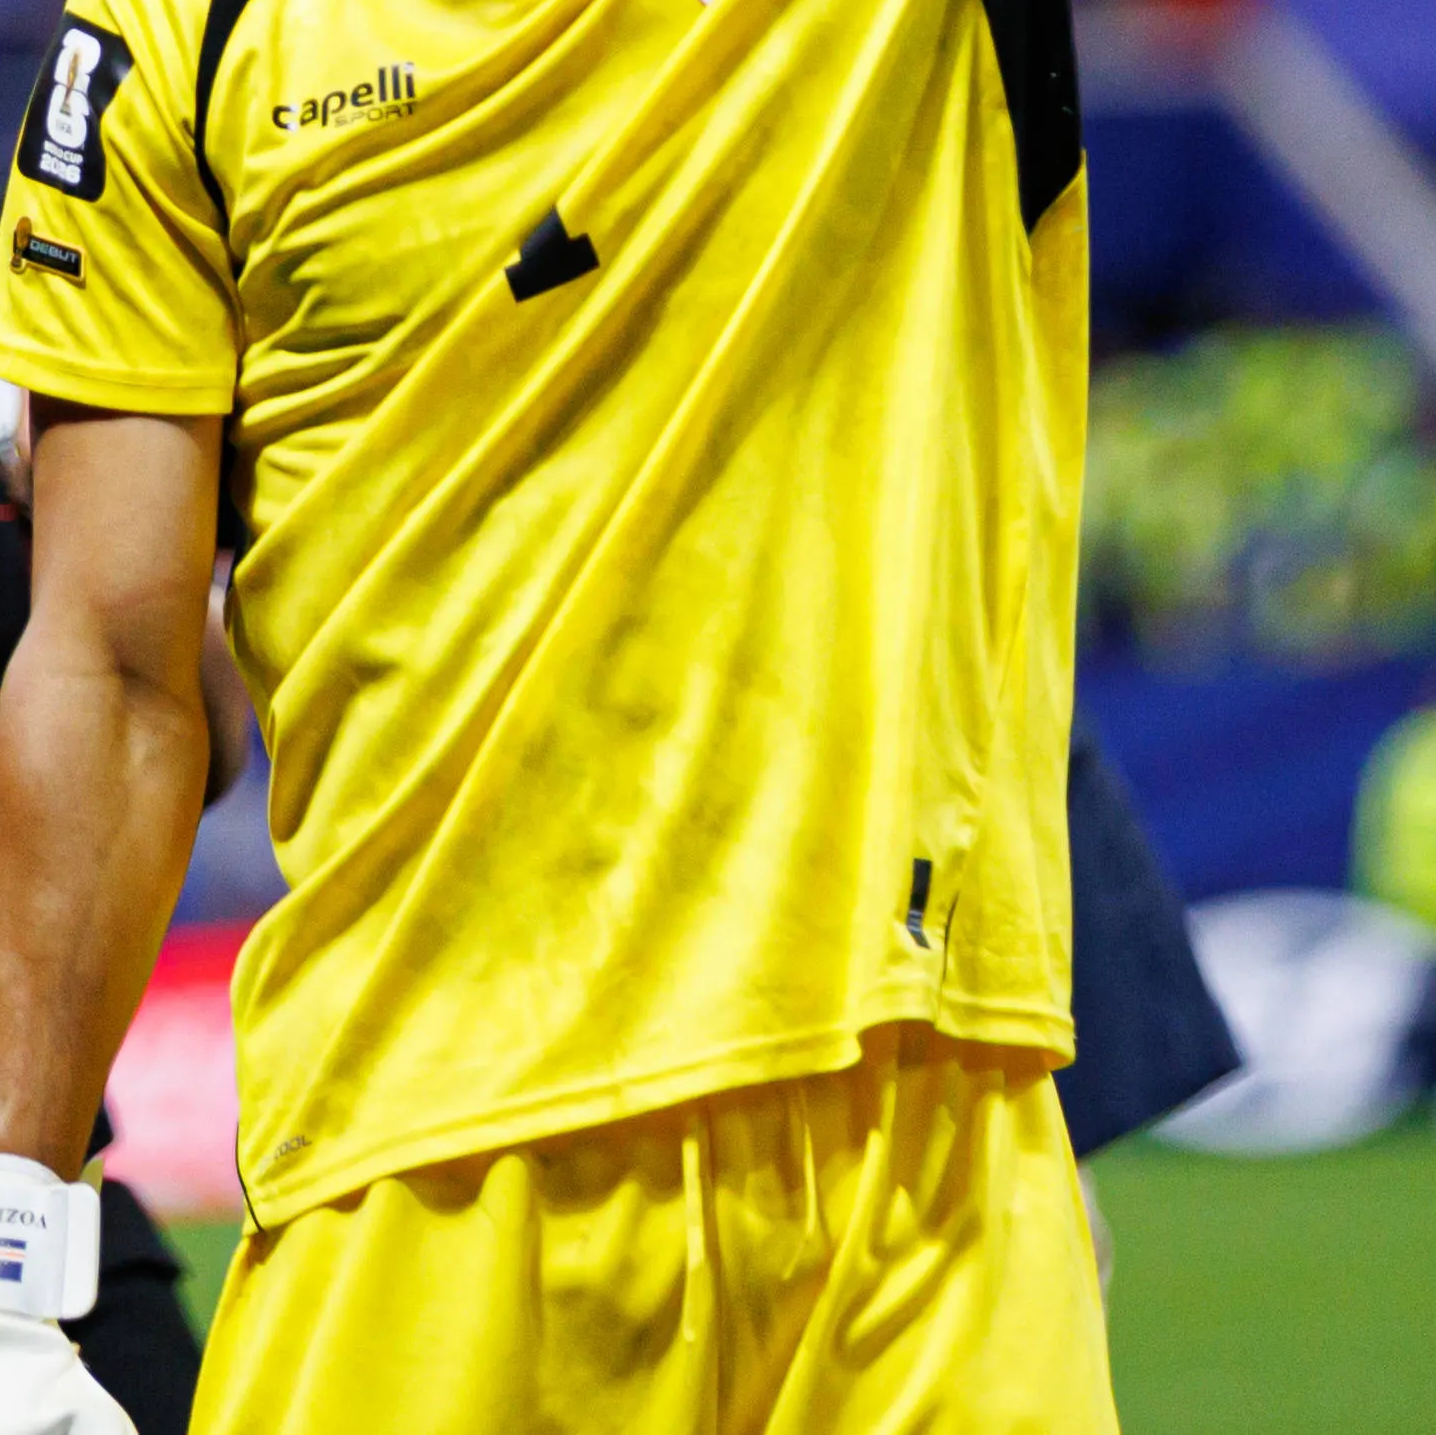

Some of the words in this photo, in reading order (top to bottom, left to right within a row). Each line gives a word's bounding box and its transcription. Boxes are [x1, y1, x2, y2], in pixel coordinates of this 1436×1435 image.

[272, 62, 415, 130] capelli
[334, 101, 416, 128] SPORT
[40, 153, 81, 184] 2026
[30, 239, 77, 263] DEBUT
